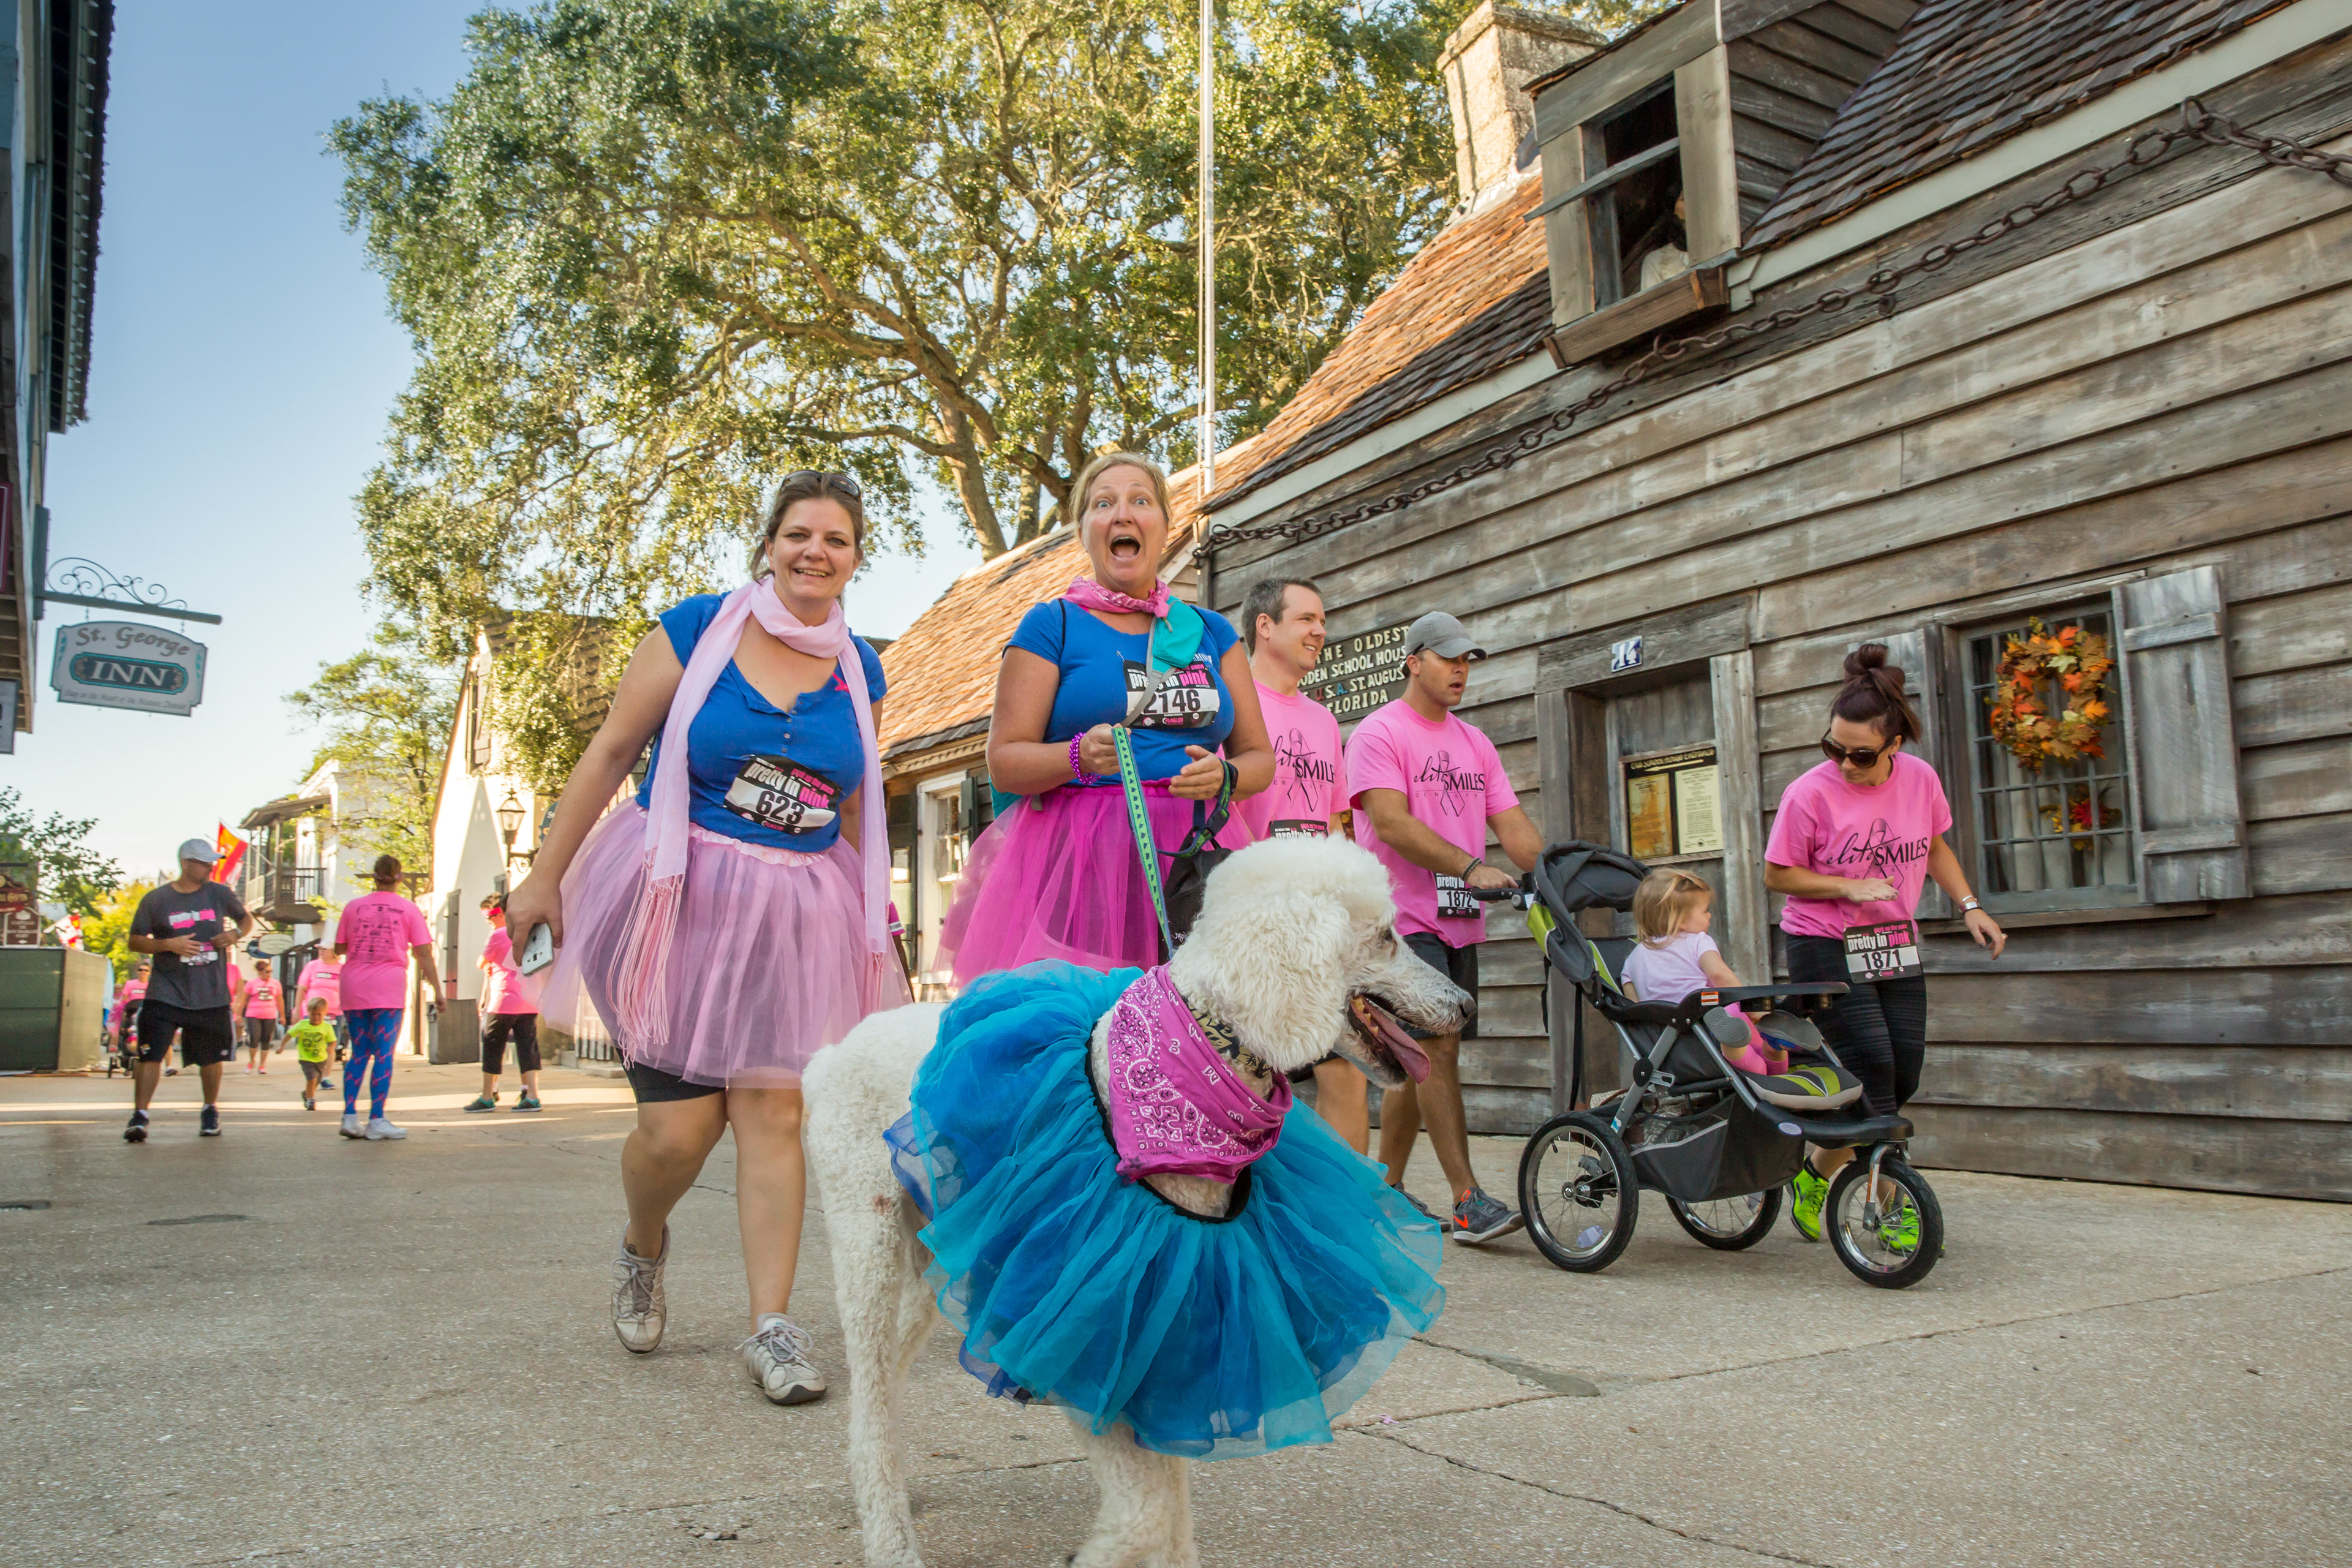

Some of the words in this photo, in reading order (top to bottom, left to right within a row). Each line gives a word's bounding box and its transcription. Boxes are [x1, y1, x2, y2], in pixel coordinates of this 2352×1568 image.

[75, 627, 106, 646] St.
[116, 627, 190, 657] George
[1317, 644, 1343, 664] THE
[1354, 625, 1409, 652] OLDEST
[1618, 640, 1636, 666] 14
[89, 660, 170, 686] INN
[1179, 670, 1210, 686] pink
[1297, 667, 1328, 687] ODEN
[1331, 655, 1374, 677] SCHOOL
[1376, 646, 1406, 666] HOUS
[1367, 666, 1406, 688] AUGUS
[1144, 689, 1200, 714] 2146
[1327, 689, 1389, 714] FLORIDA
[1295, 757, 1335, 784] SMILE
[1444, 773, 1485, 791] SMILES
[744, 762, 787, 791] pretty
[784, 775, 801, 797] in
[799, 786, 829, 809] pink
[756, 791, 805, 824] 623
[1875, 837, 1928, 866] SMILES
[1436, 876, 1458, 889] pretty
[1446, 891, 1472, 908] 1872
[1847, 935, 1876, 952] pretty
[1876, 933, 1888, 948] in
[1888, 930, 1910, 948] pink
[1862, 949, 1902, 970] 1871
